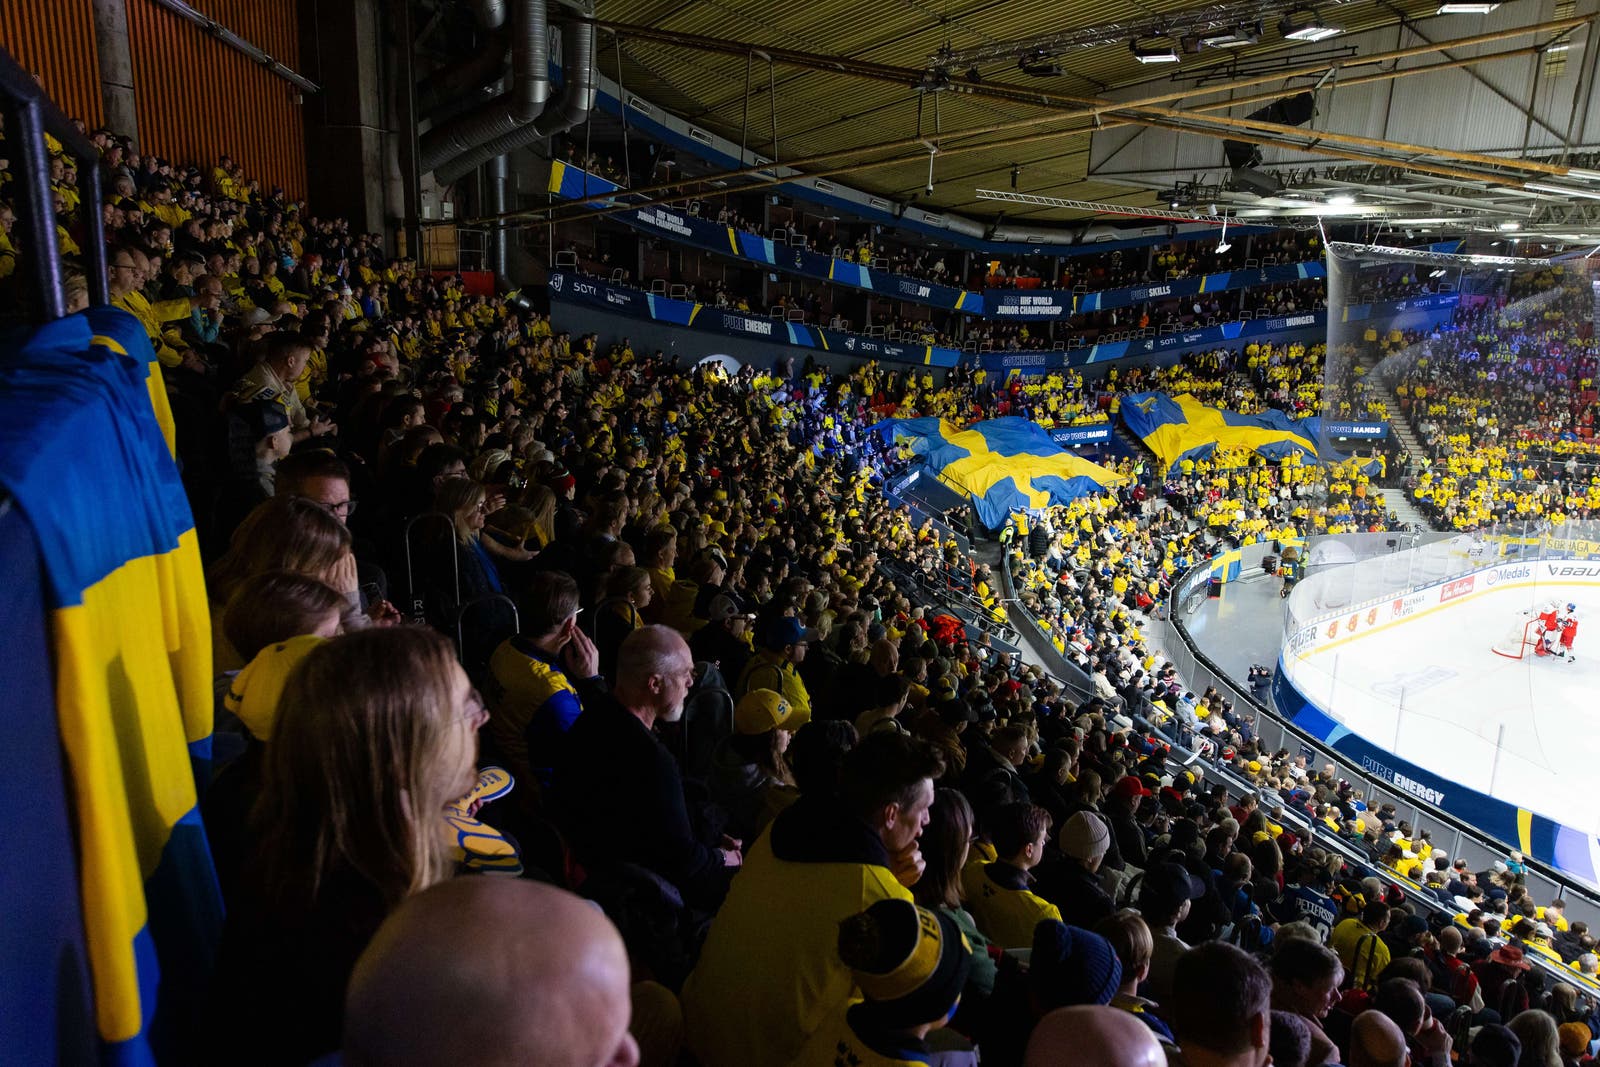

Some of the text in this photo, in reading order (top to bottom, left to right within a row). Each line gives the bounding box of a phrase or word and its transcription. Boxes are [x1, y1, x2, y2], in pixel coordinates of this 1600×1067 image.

[917, 285, 931, 298] JOY
[1149, 284, 1171, 298] SKILLS
[1032, 295, 1053, 306] WORLD
[996, 305, 1063, 315] JUNIOR CHAMPIONSHIP
[723, 314, 772, 336] PURE ENERGY
[1286, 314, 1315, 327] HUNGER
[1087, 429, 1108, 439] HANDS
[1352, 426, 1381, 434] HANDS
[1499, 566, 1531, 581] Medals
[1363, 755, 1445, 806] PURE ENERGY
